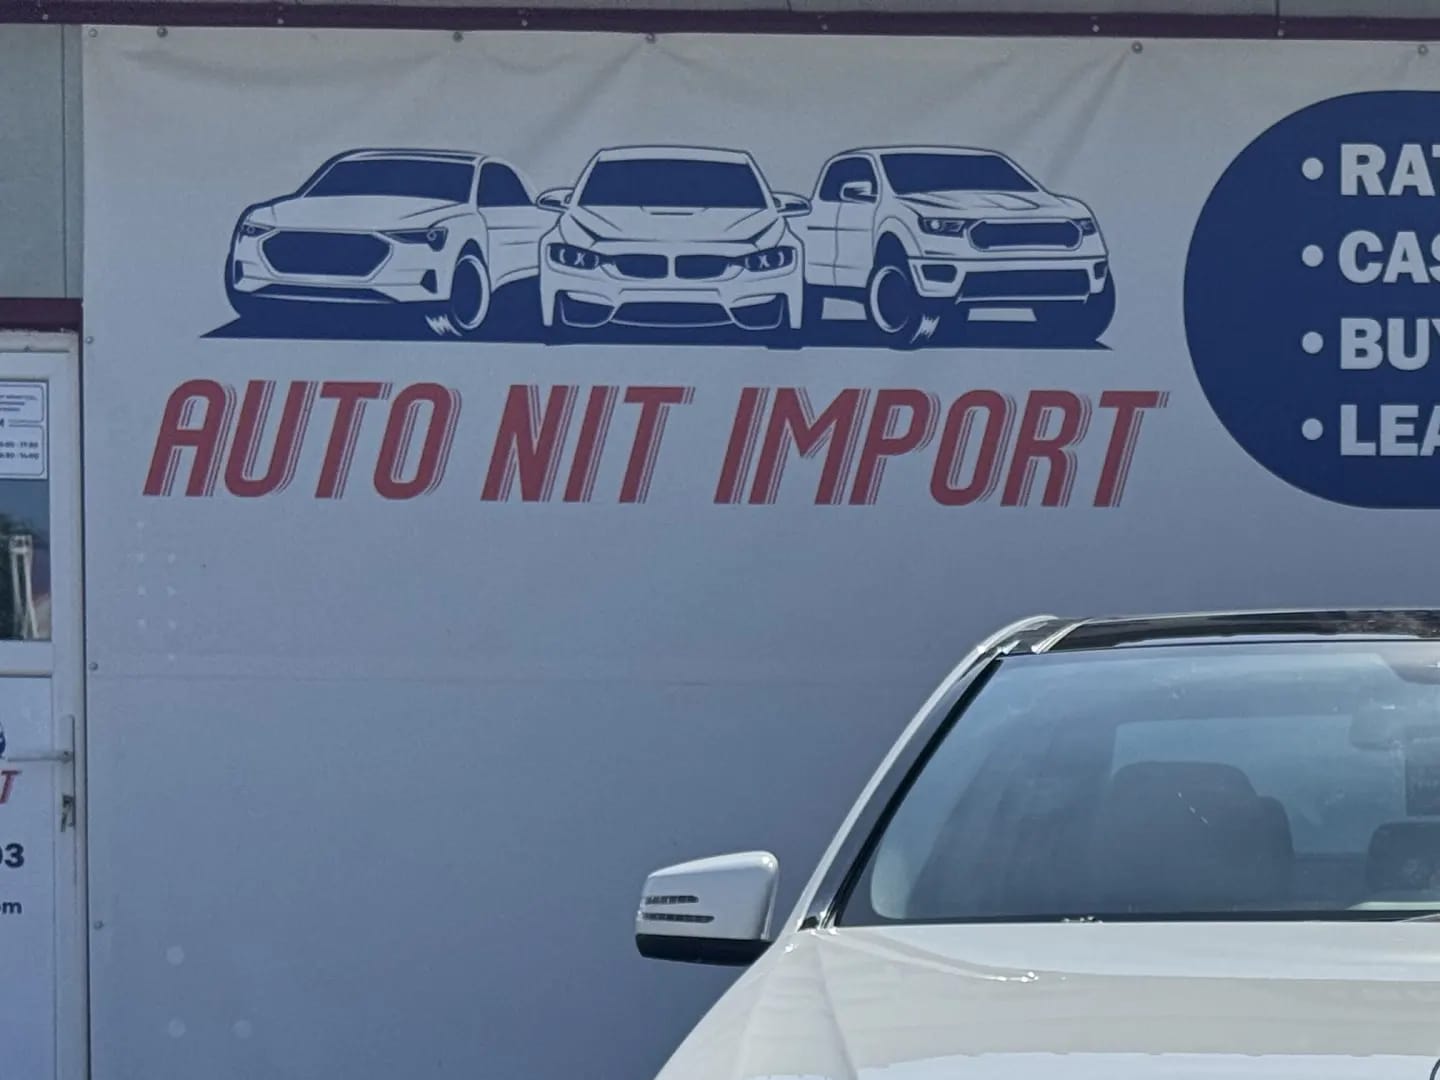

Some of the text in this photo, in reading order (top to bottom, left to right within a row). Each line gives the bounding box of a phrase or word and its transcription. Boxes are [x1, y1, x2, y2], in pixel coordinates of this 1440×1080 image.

[142, 379, 1171, 508] AUTO NIT IMPORT
